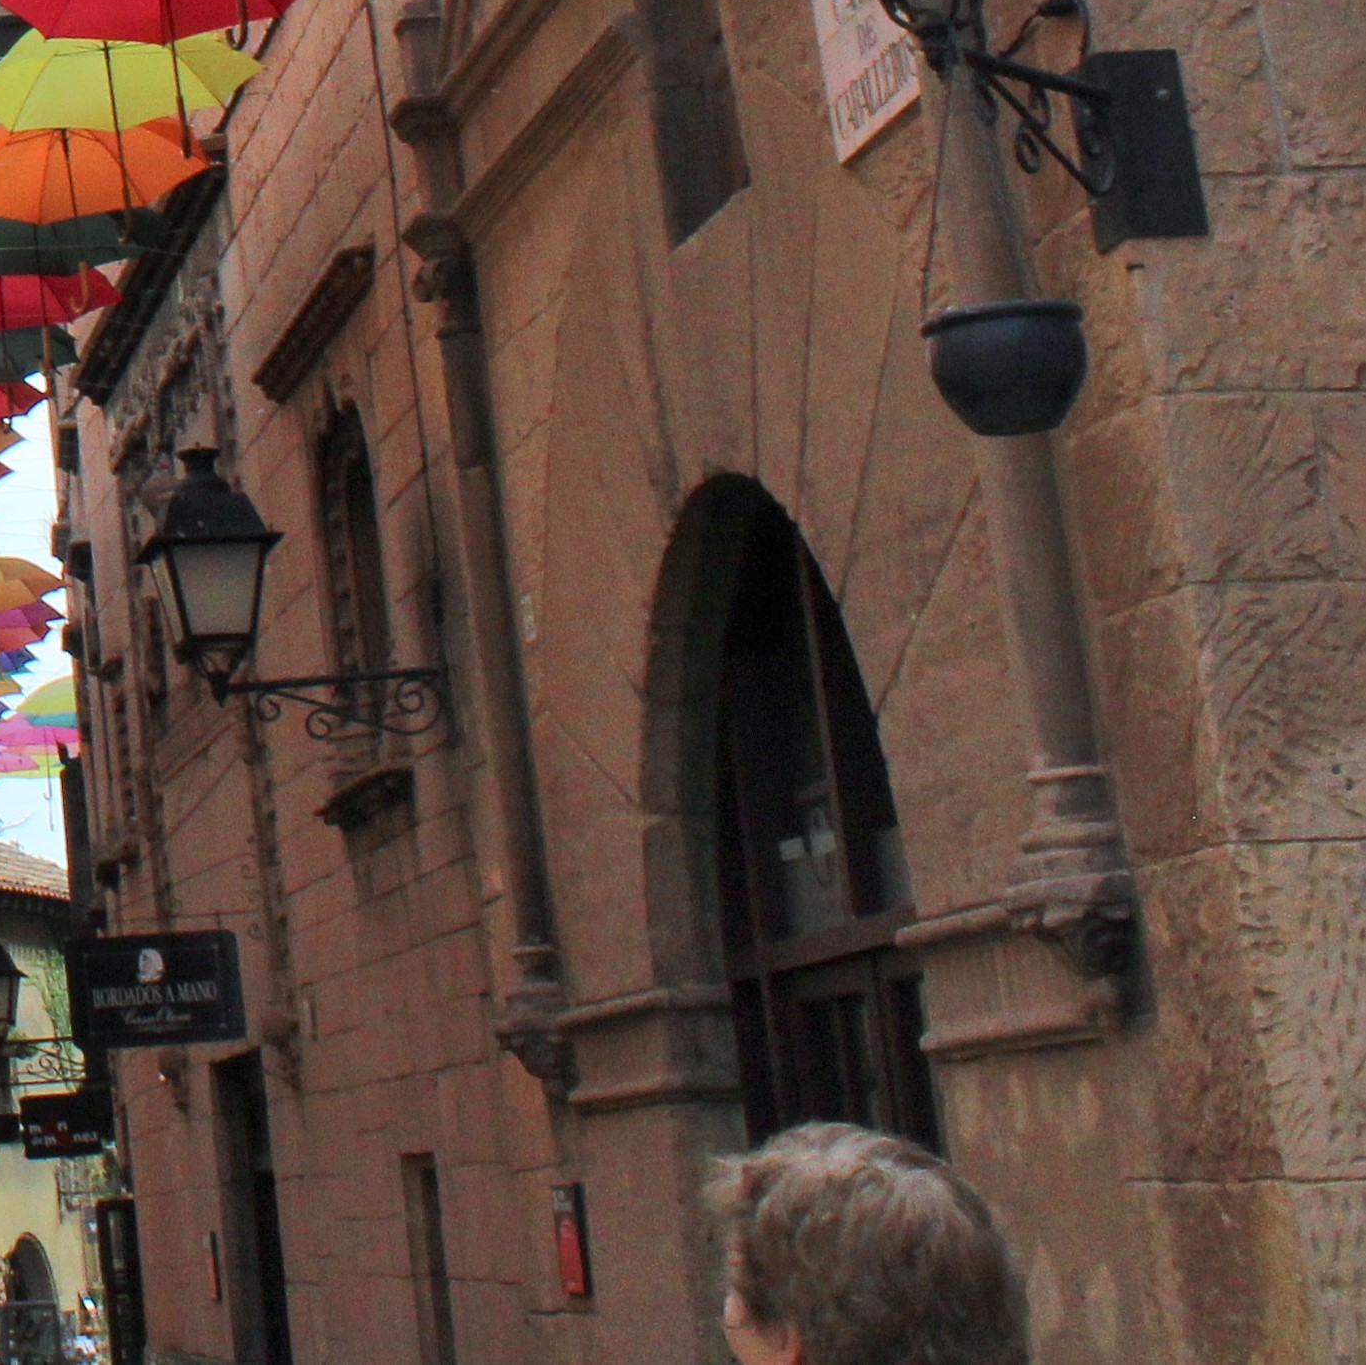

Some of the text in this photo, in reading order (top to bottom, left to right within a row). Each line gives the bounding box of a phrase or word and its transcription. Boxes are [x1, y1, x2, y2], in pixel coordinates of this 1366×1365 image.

[91, 979, 218, 1009] BORDADOS A MANO
